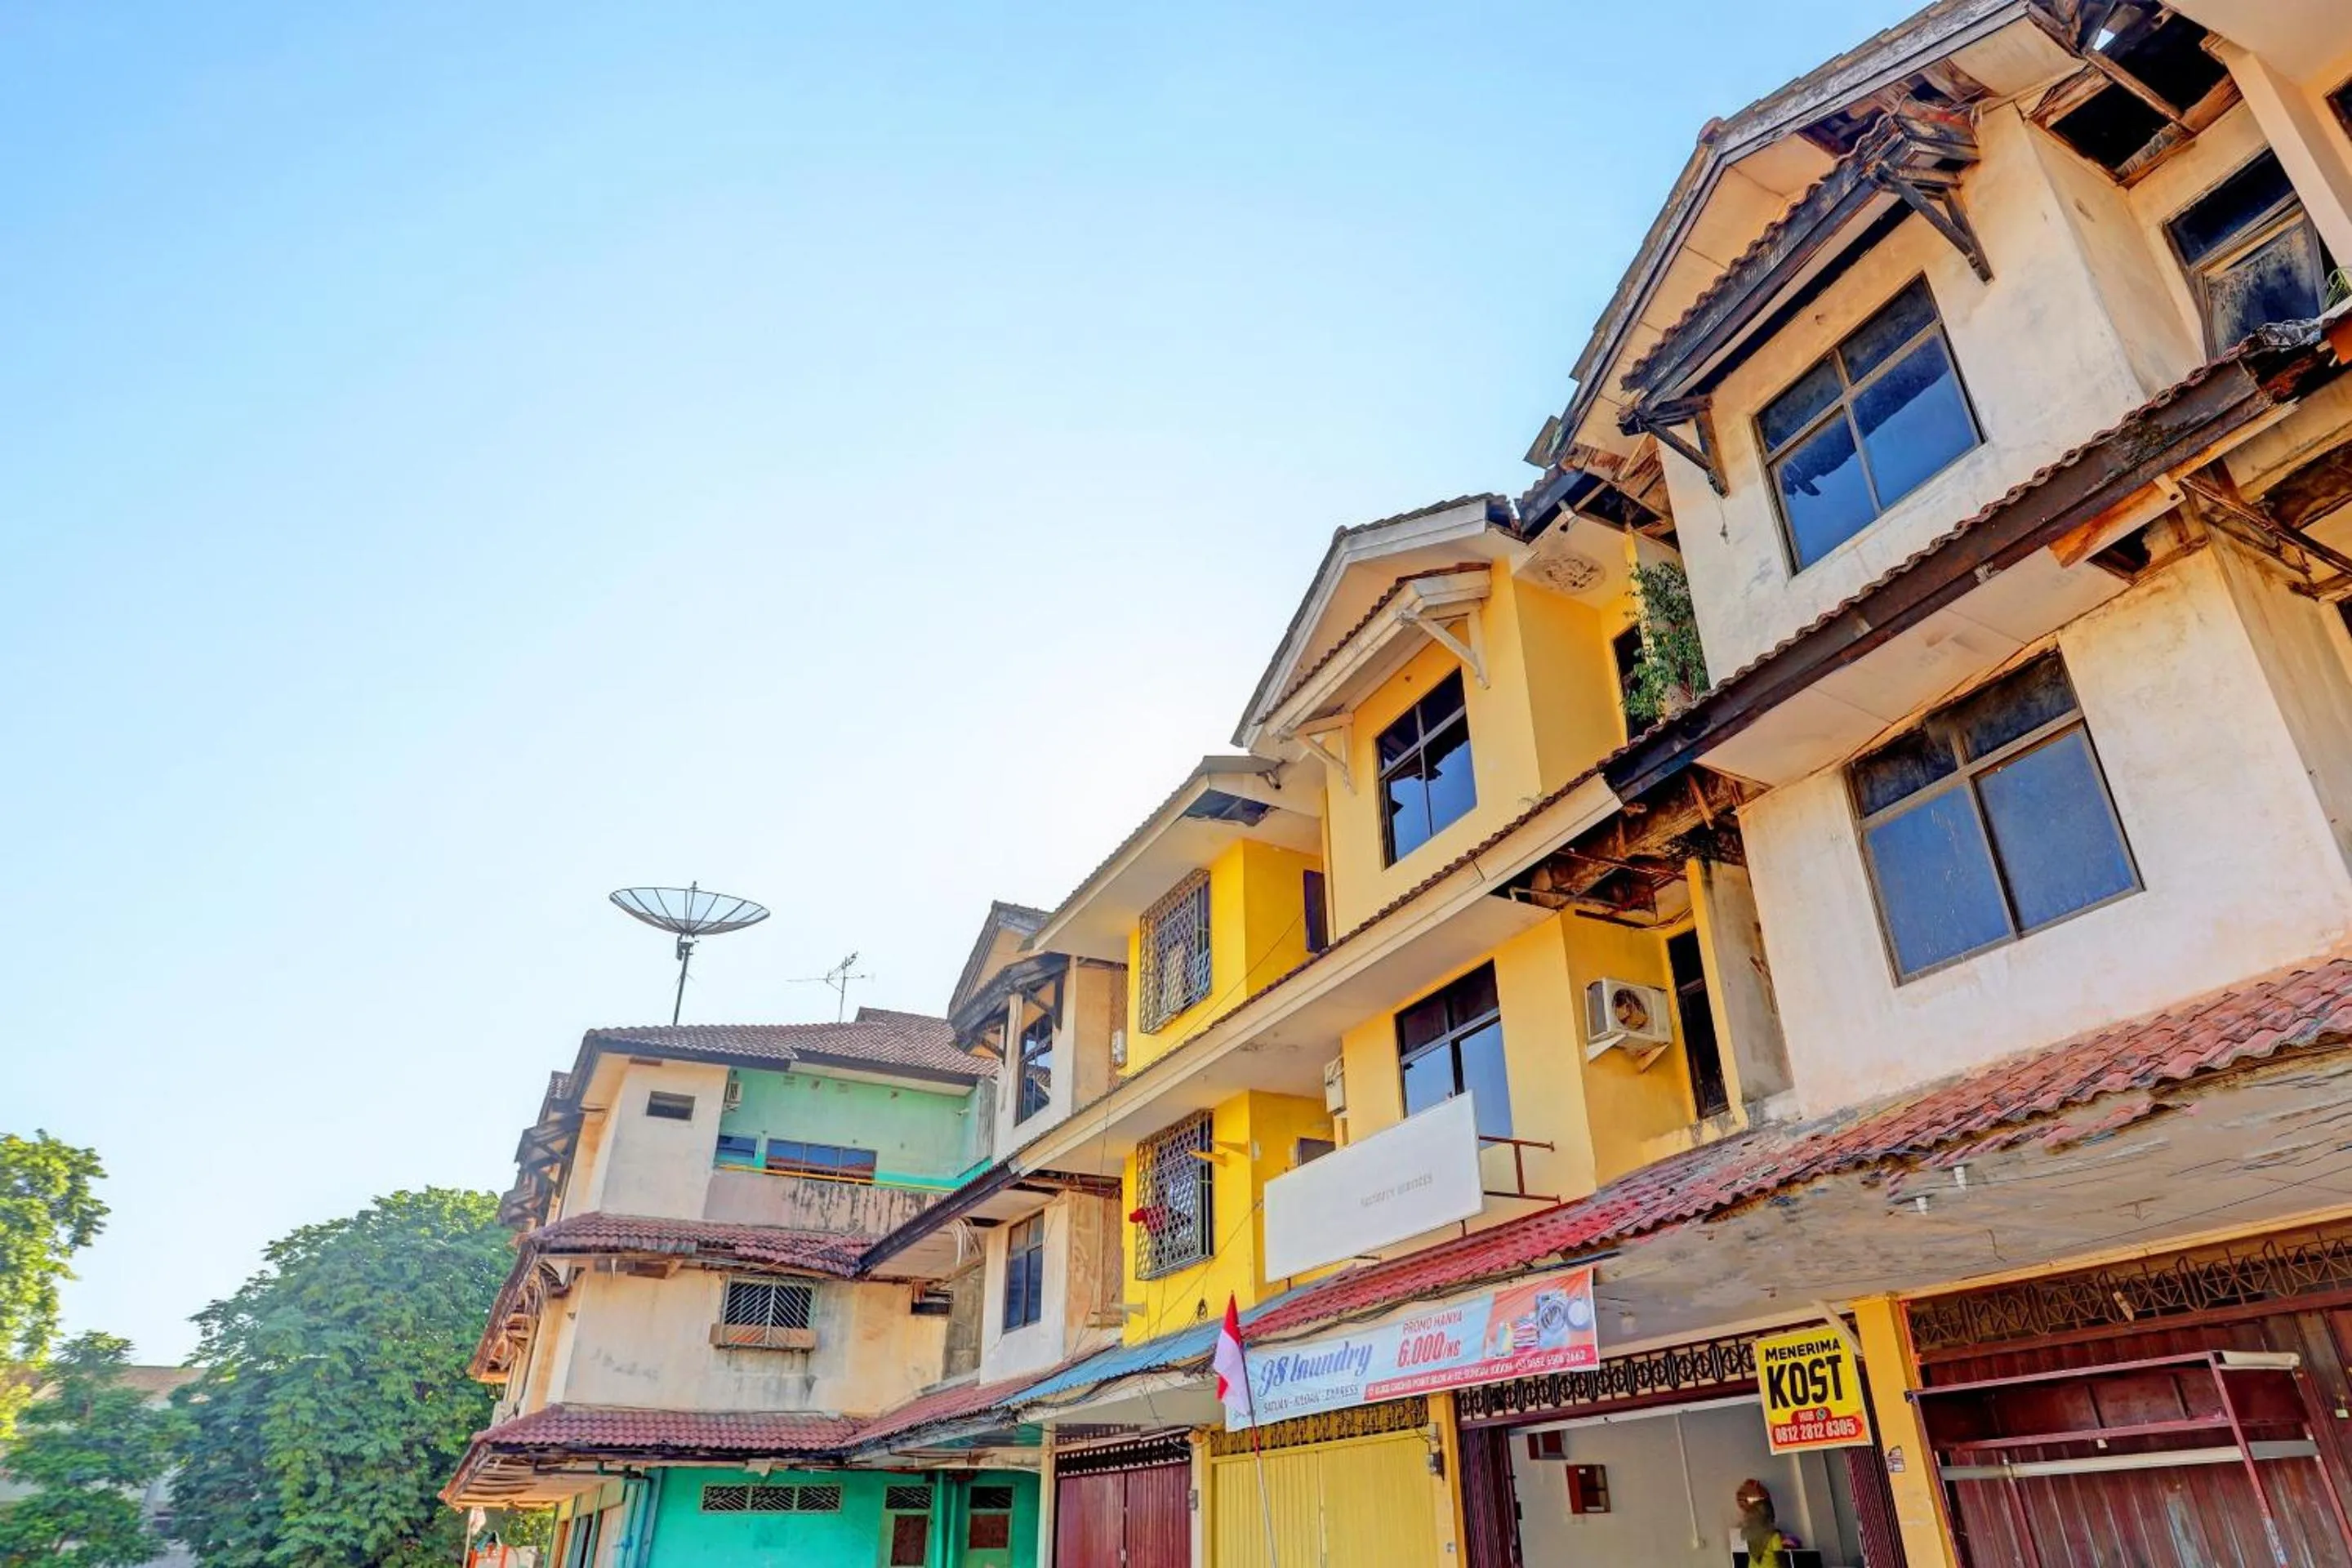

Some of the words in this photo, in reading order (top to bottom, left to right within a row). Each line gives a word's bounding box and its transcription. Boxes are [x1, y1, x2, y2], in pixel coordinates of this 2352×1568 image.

[1403, 1317, 1432, 1334] PROMO
[1433, 1309, 1462, 1327] HANYA
[1290, 1340, 1373, 1383] laundry
[1765, 1338, 1842, 1362] MENERIMA
[1325, 1383, 1359, 1401] EXPRESS
[1766, 1354, 1843, 1410] KOST
[1775, 1423, 1799, 1444] 0812
[1799, 1420, 1826, 1441] 2812
